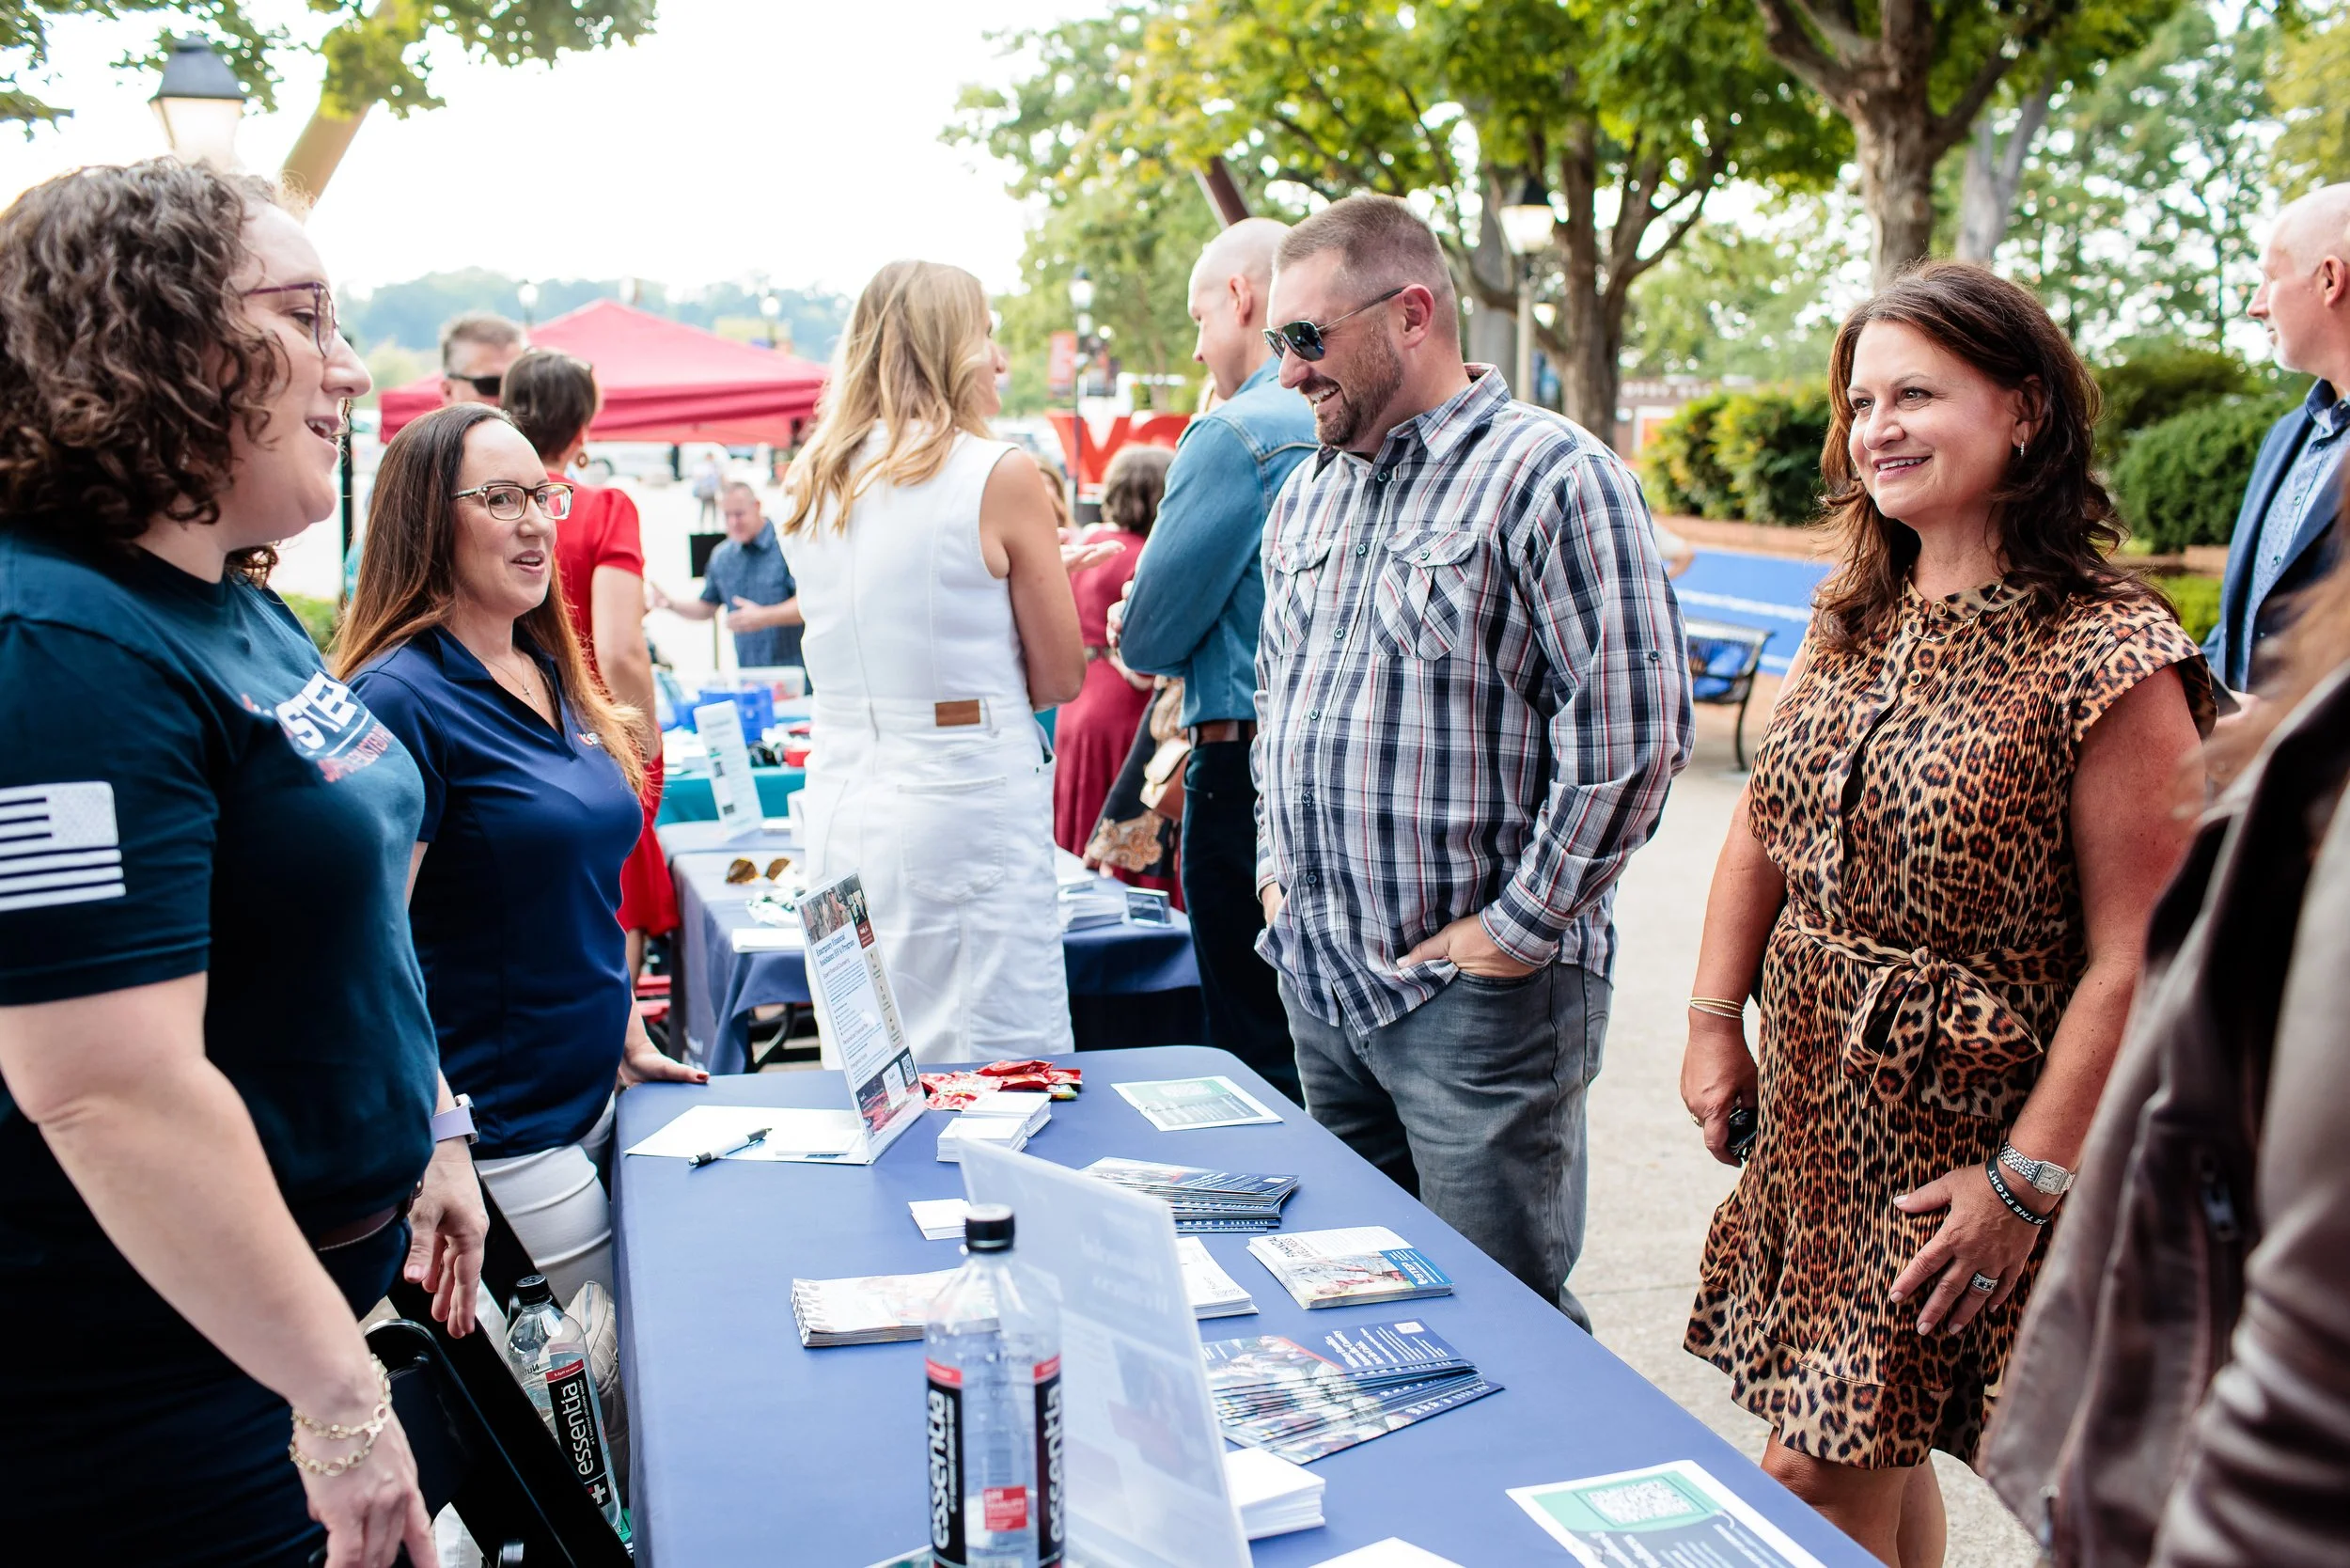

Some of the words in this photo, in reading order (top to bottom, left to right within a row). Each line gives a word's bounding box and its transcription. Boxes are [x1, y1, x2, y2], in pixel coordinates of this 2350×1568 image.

[1988, 1169, 2014, 1205] FIGHT
[2013, 1205, 2034, 1222] THE
[560, 1382, 593, 1475] essentia
[928, 1389, 949, 1549] essentia
[1044, 1383, 1064, 1543] essentia
